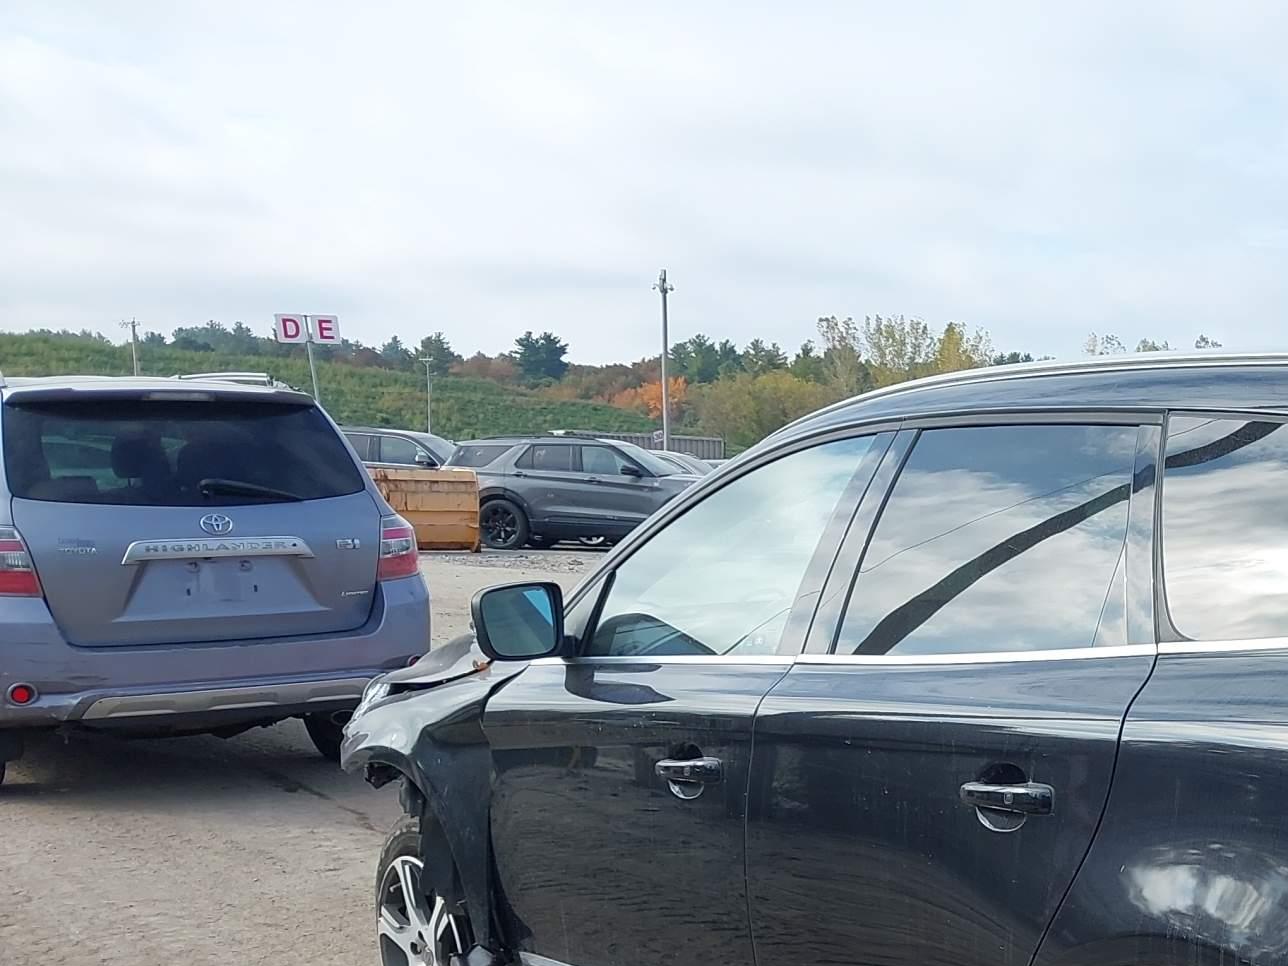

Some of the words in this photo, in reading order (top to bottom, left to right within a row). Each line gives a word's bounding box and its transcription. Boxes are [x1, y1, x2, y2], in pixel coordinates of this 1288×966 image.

[281, 318, 300, 339] D
[318, 320, 335, 339] E
[144, 542, 288, 553] HIGHLANDER
